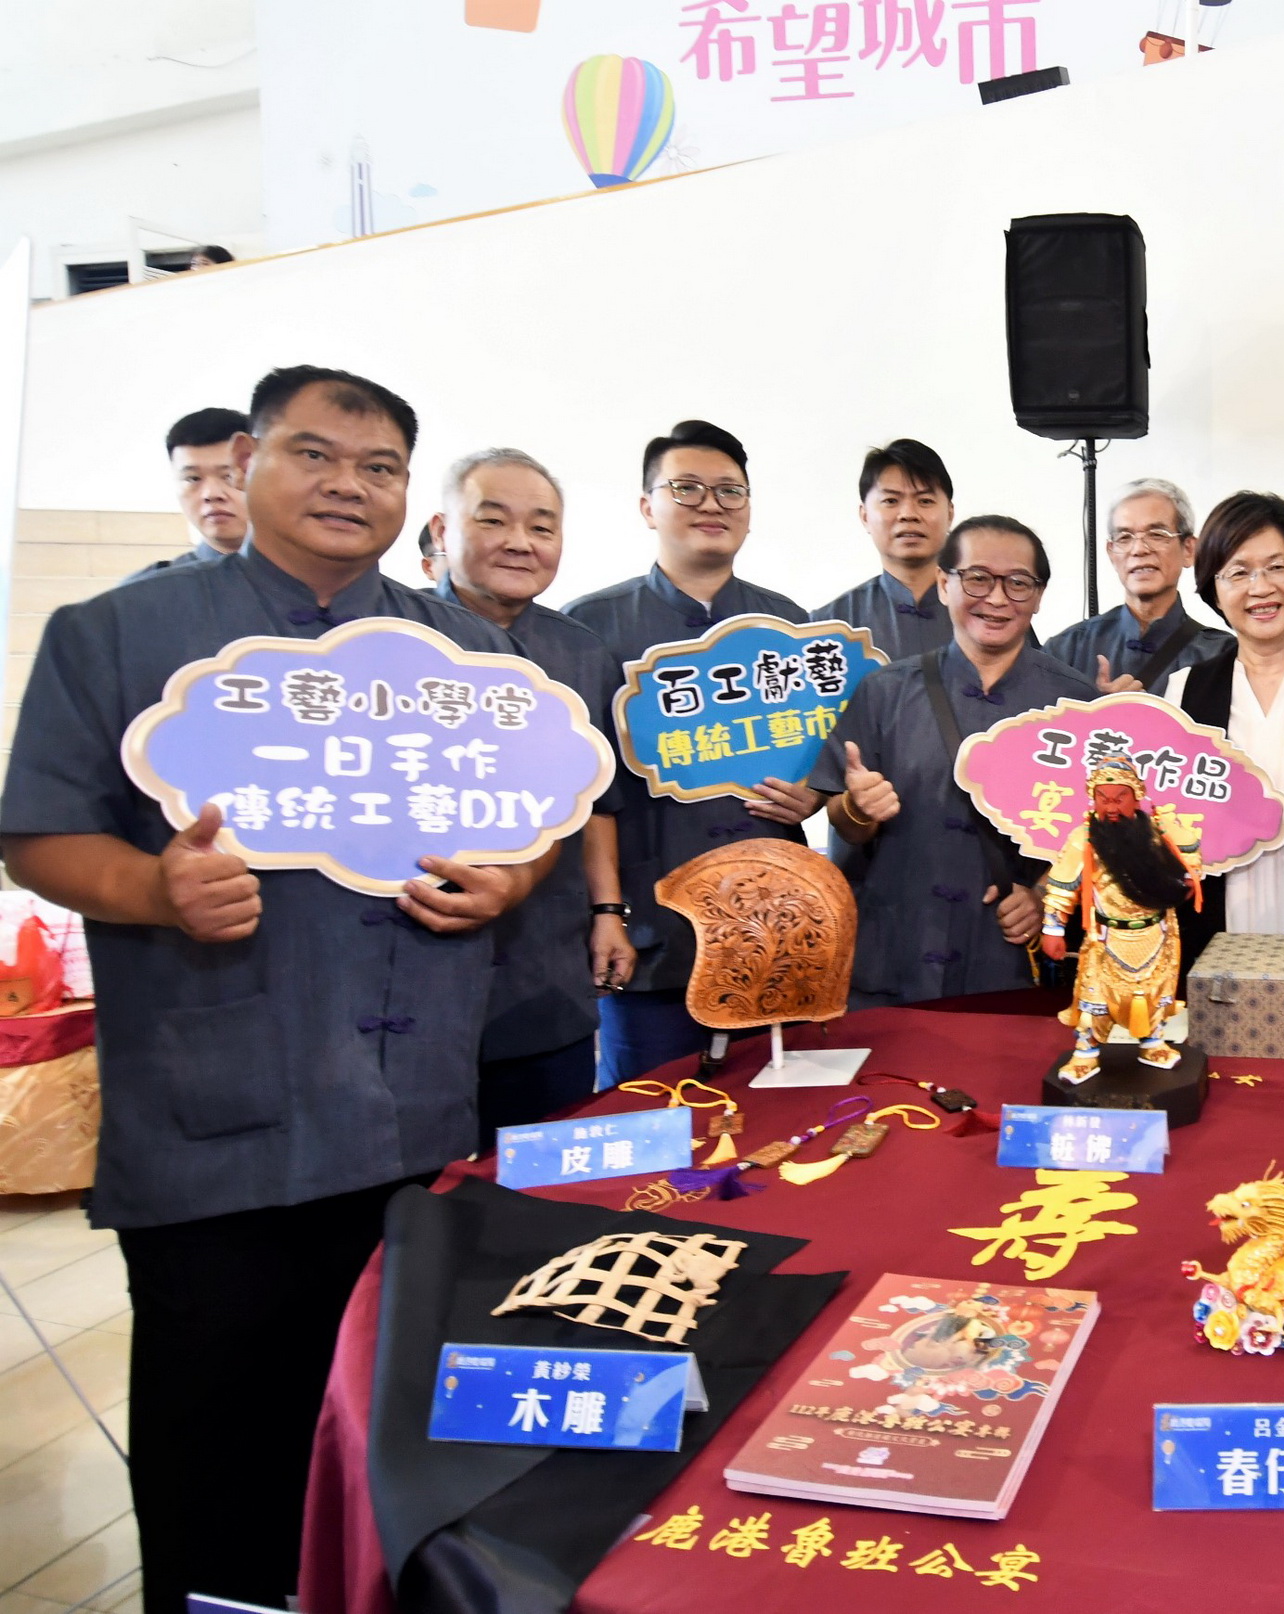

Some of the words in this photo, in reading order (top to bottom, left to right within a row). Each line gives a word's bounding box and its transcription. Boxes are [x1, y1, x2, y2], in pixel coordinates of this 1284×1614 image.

[679, 0, 1042, 102] 希望城市
[216, 670, 537, 728] 工藝小學堂
[654, 639, 847, 717] 百工獻藝
[252, 733, 500, 782] 一日手作
[657, 700, 848, 768] 傳統工藝市
[206, 783, 556, 834] 傳統工藝DIY
[560, 1140, 634, 1176] 皮雕
[508, 1388, 606, 1434] 木雕
[634, 1505, 1041, 1591] 鹿港魯班公宴
